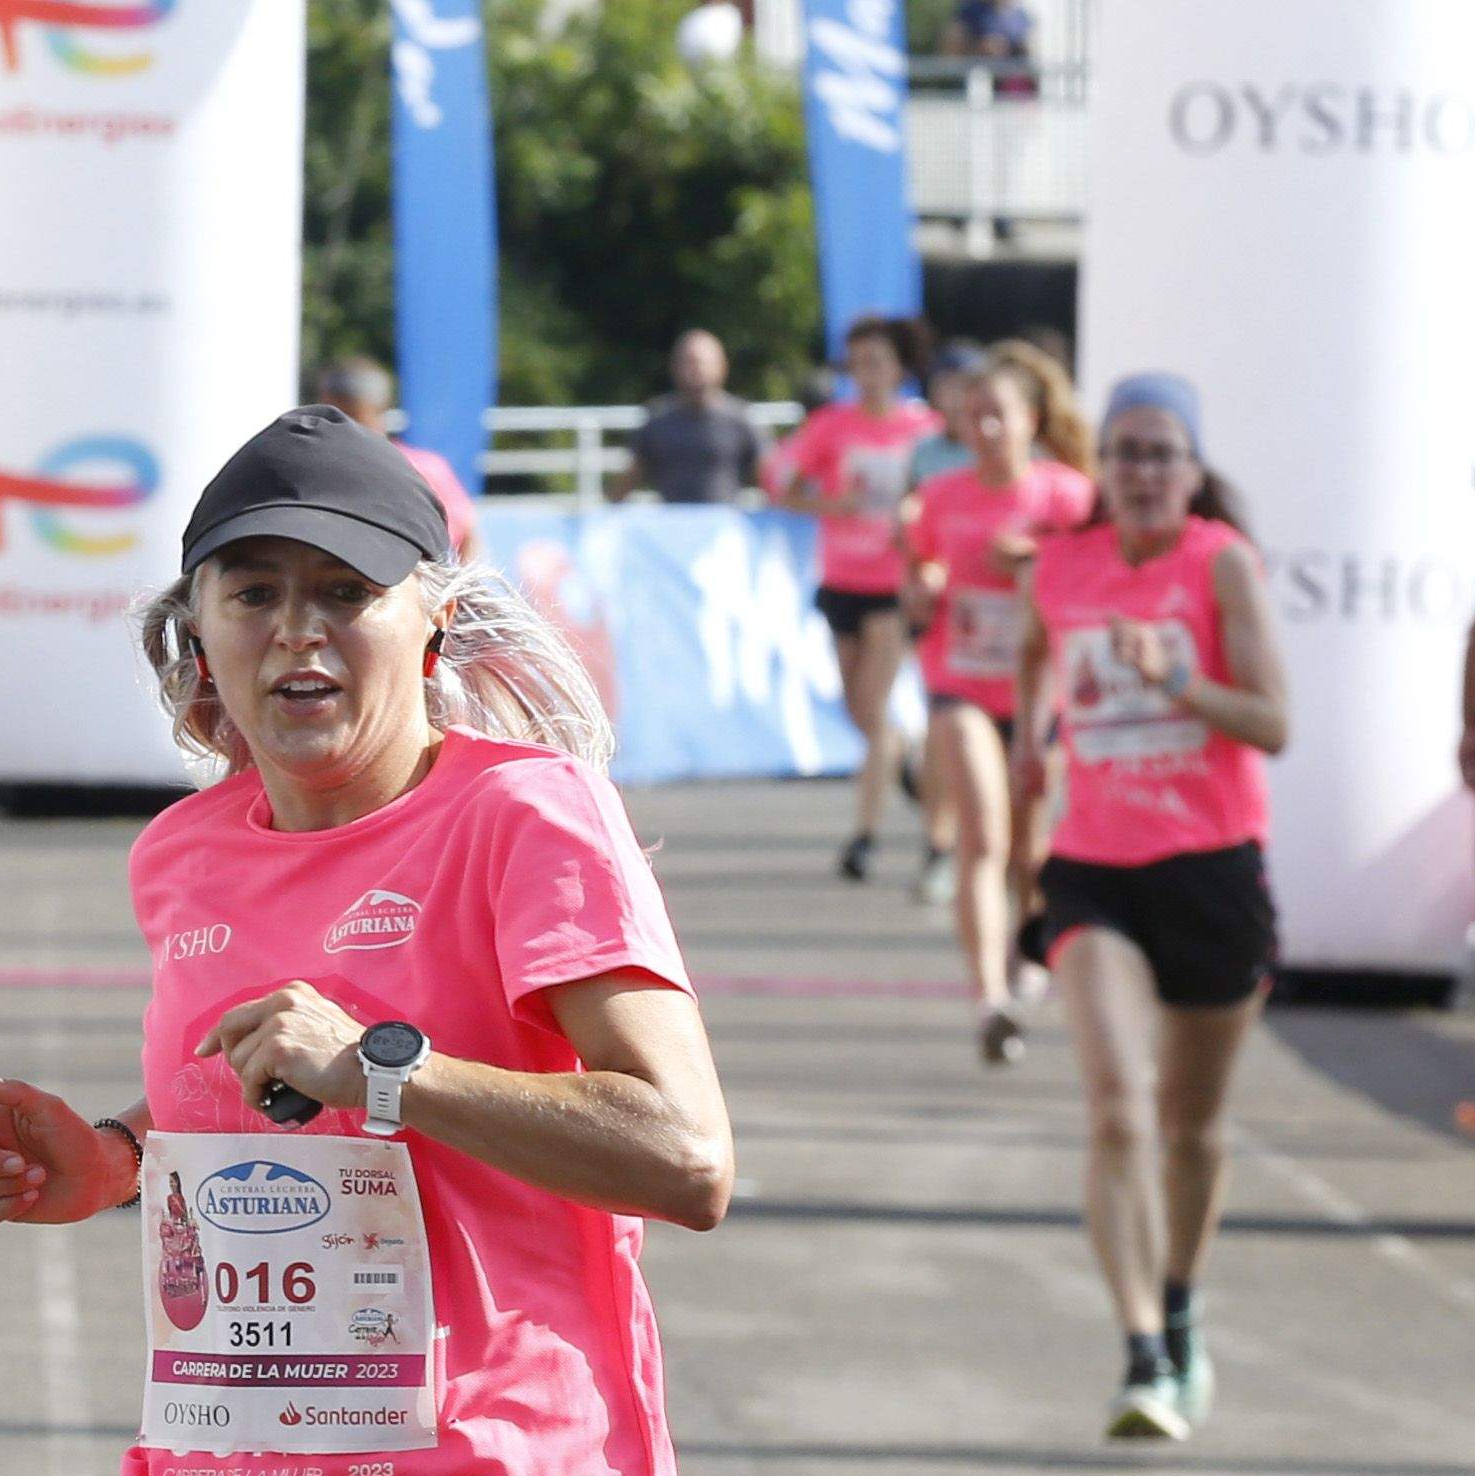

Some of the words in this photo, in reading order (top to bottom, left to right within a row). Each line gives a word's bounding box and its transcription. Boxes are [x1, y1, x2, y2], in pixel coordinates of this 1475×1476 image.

[339, 1168, 352, 1177] TU
[355, 1169, 396, 1180] DORSAL
[341, 1179, 397, 1196] SUMA
[205, 1187, 321, 1215] ASTURIANA
[215, 1262, 316, 1304] 016
[230, 1322, 291, 1347] 3511
[173, 1361, 226, 1377] CARRERA
[229, 1364, 253, 1379] DE
[257, 1364, 280, 1379] LA
[284, 1364, 349, 1379] MUJER
[355, 1364, 399, 1379] 2023
[165, 1402, 230, 1427] OYSHO
[306, 1407, 408, 1425] Santander
